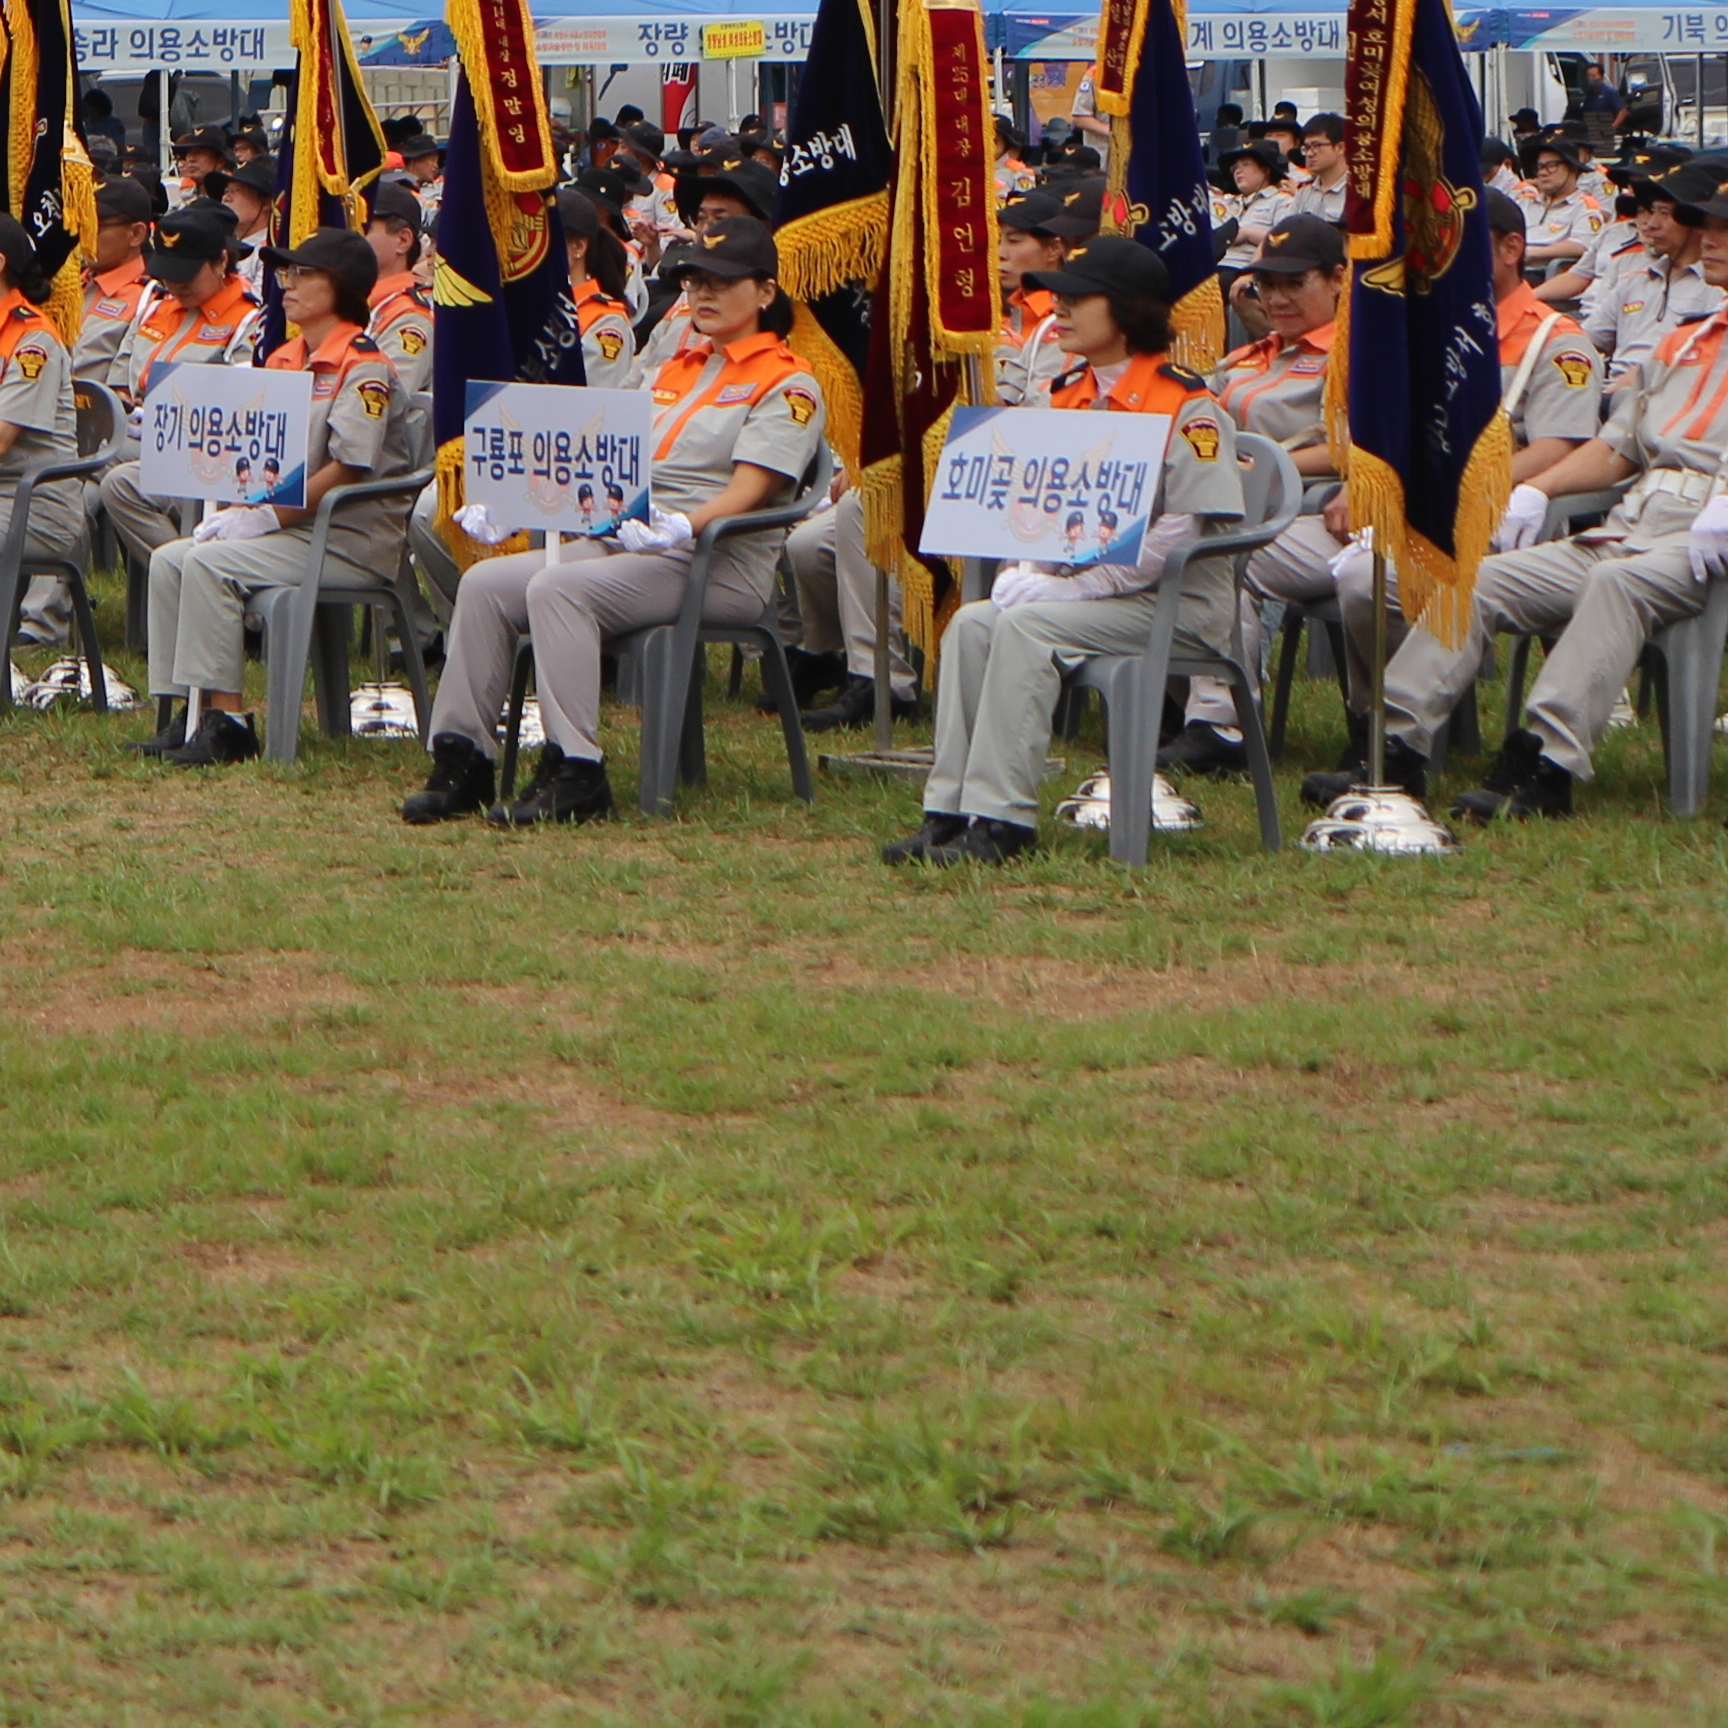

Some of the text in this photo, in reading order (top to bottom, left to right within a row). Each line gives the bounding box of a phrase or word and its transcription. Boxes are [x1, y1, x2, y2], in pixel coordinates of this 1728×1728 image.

[129, 27, 266, 63] 의용소방대
[637, 22, 689, 56] 장량
[1223, 20, 1340, 53] 의용소방대
[1661, 14, 1706, 45] 기북
[154, 402, 288, 461] 장기 의용소방대
[471, 427, 641, 488] 구룡포 의용소방대
[941, 451, 1148, 517] 호미곶 의용소방대
